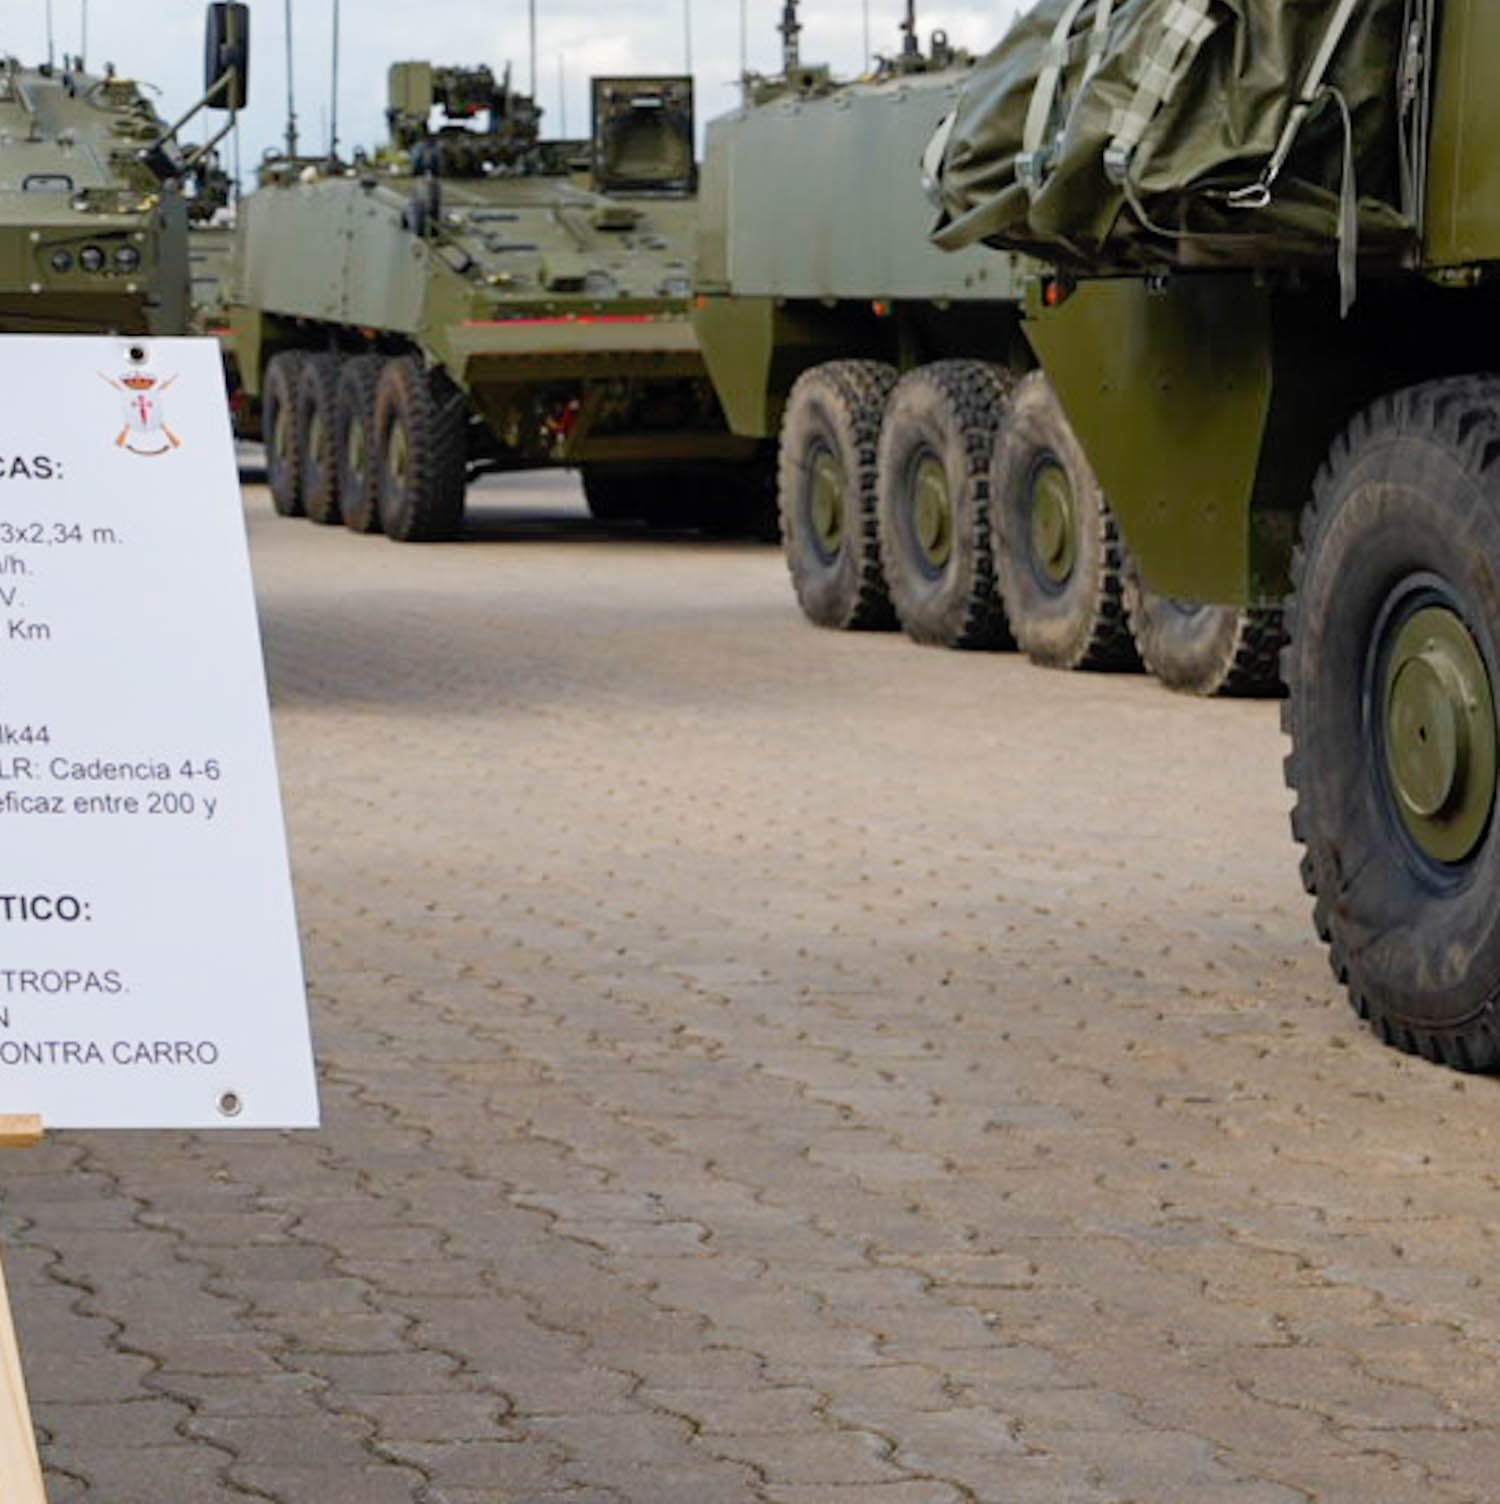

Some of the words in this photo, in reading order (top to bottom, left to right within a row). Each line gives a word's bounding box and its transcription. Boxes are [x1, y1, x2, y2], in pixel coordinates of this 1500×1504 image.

[92, 528, 122, 543] m.
[8, 620, 50, 639] Km
[49, 757, 171, 780] Cadencia
[179, 759, 220, 780] 4-6
[73, 794, 139, 814] entre
[147, 791, 194, 814] 200
[203, 798, 217, 820] y
[0, 970, 128, 994] TROPAS.
[112, 1041, 218, 1064] CARRO
